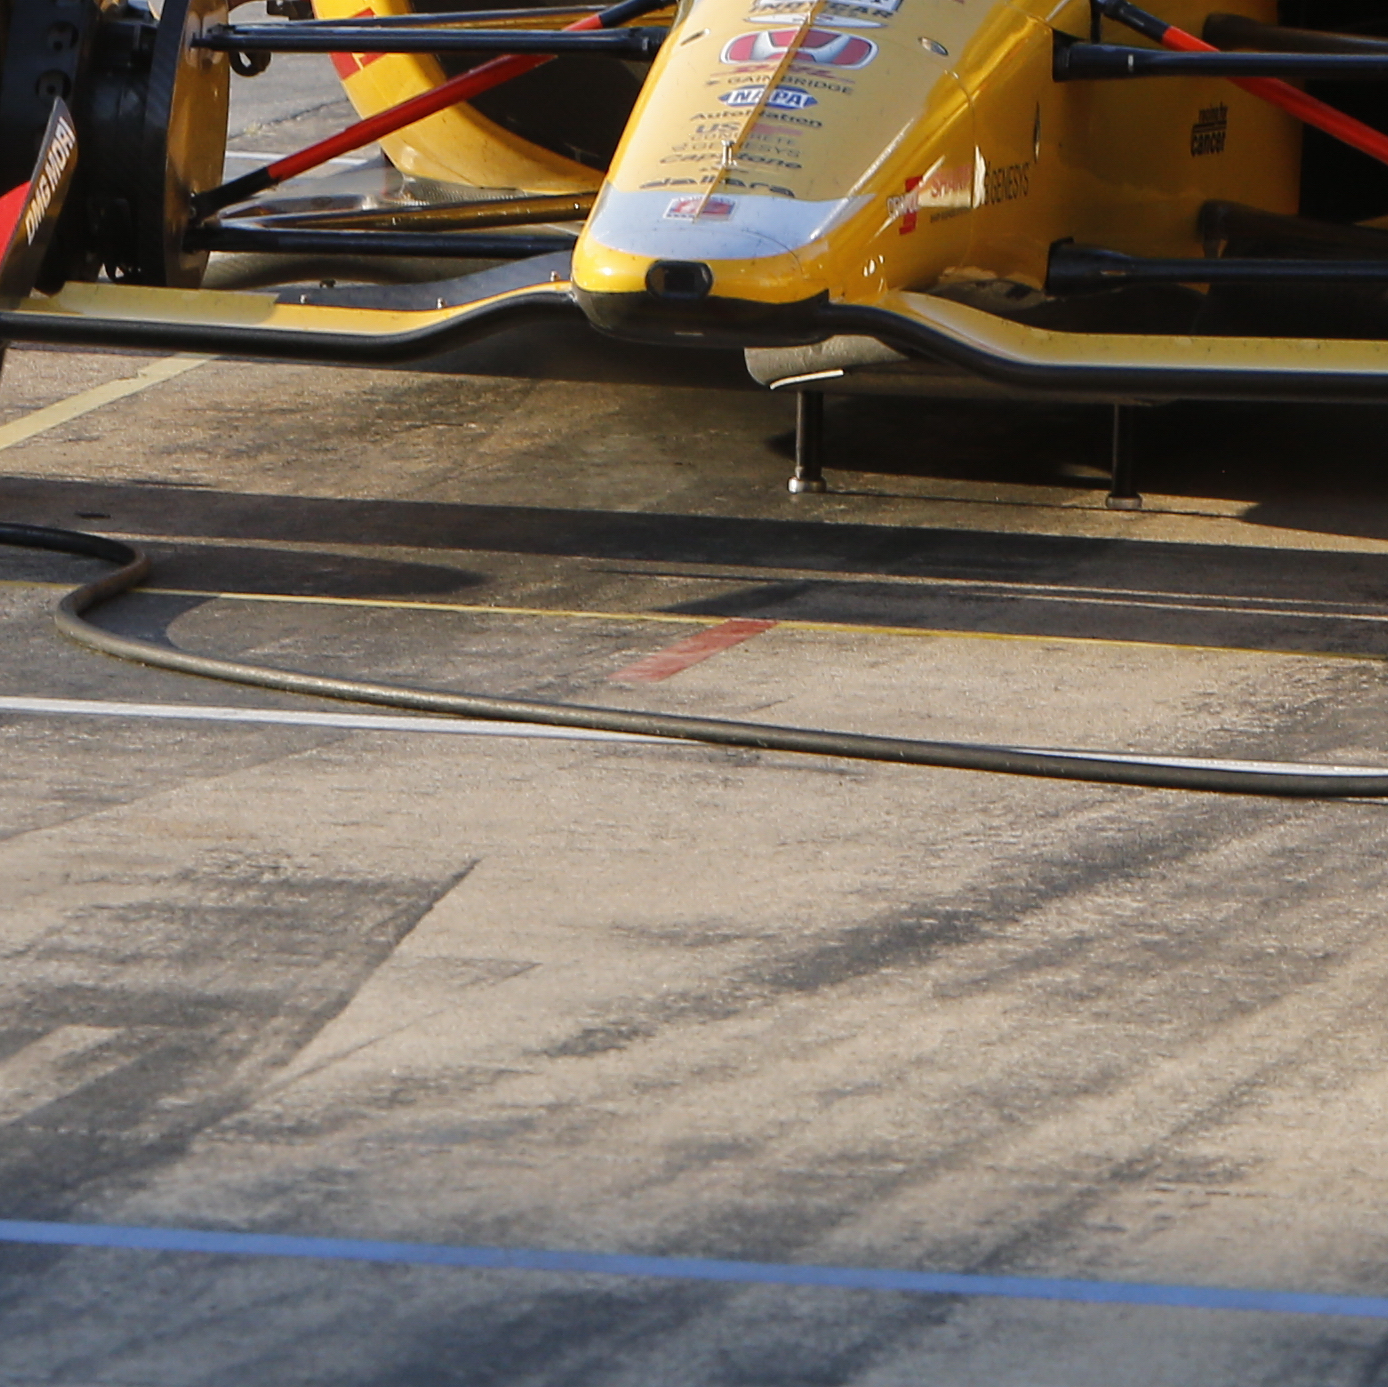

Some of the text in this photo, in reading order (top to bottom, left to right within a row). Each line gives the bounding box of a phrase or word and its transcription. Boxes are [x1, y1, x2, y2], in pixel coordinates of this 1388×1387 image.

[695, 122, 742, 135] US
[25, 115, 76, 247] DMG MORI
